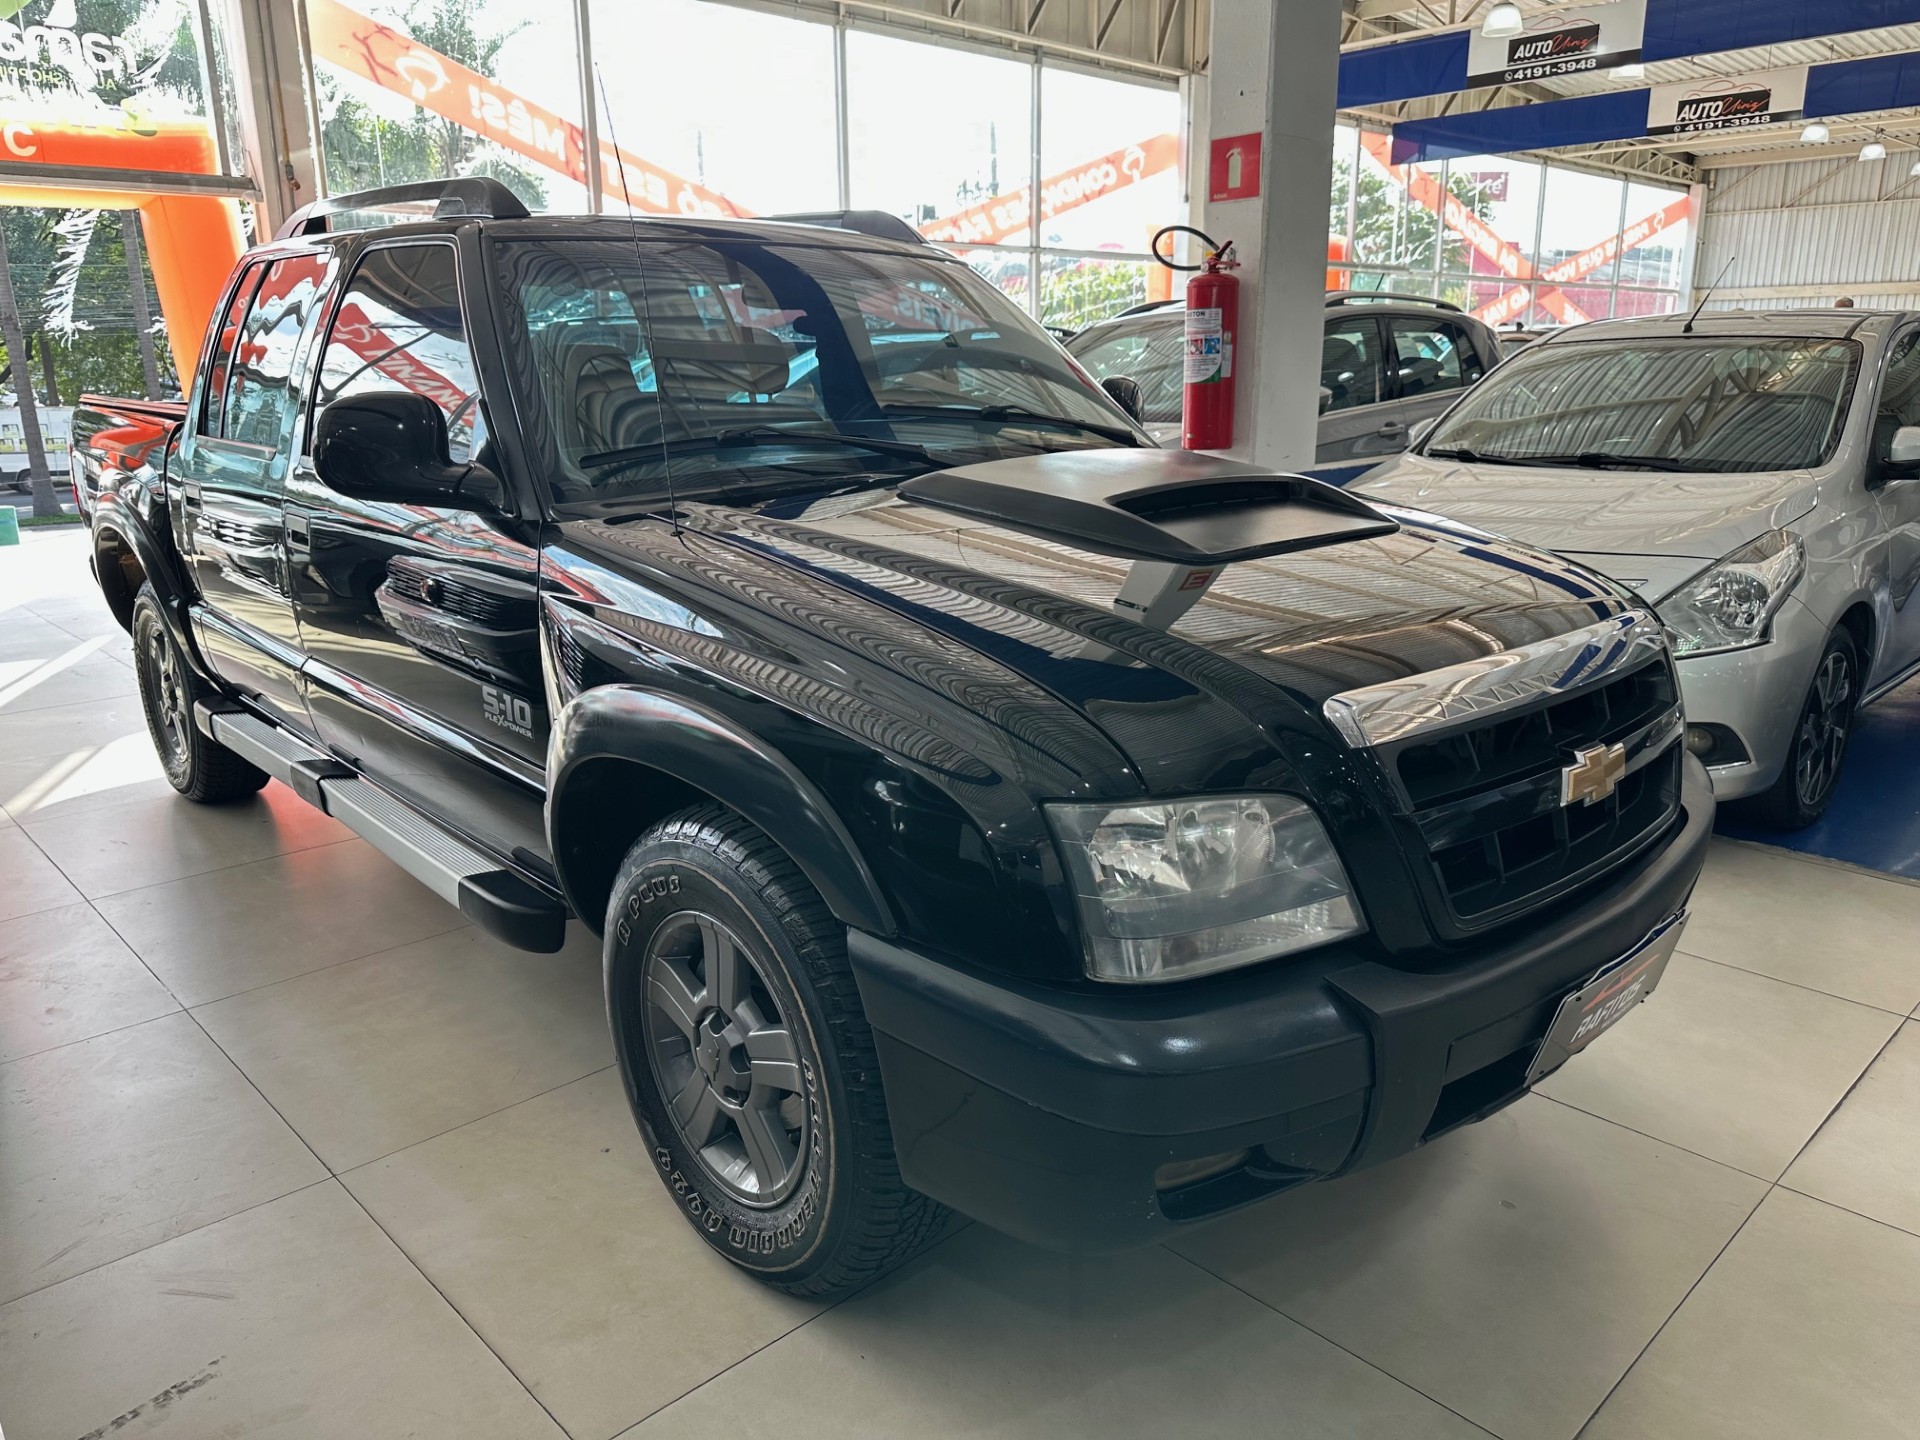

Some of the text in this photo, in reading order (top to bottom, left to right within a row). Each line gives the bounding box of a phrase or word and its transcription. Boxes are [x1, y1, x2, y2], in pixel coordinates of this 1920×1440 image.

[1514, 39, 1553, 60] AUTO
[1513, 58, 1597, 80] 4191-3948
[1678, 100, 1723, 121] AUTO
[1685, 115, 1771, 132] 4191-3948
[482, 685, 532, 729] S-10
[484, 712, 533, 739] FLEXPOWER
[628, 874, 680, 920] PLUS
[656, 1147, 725, 1232] A929
[728, 1169, 822, 1254] TERRAIN
